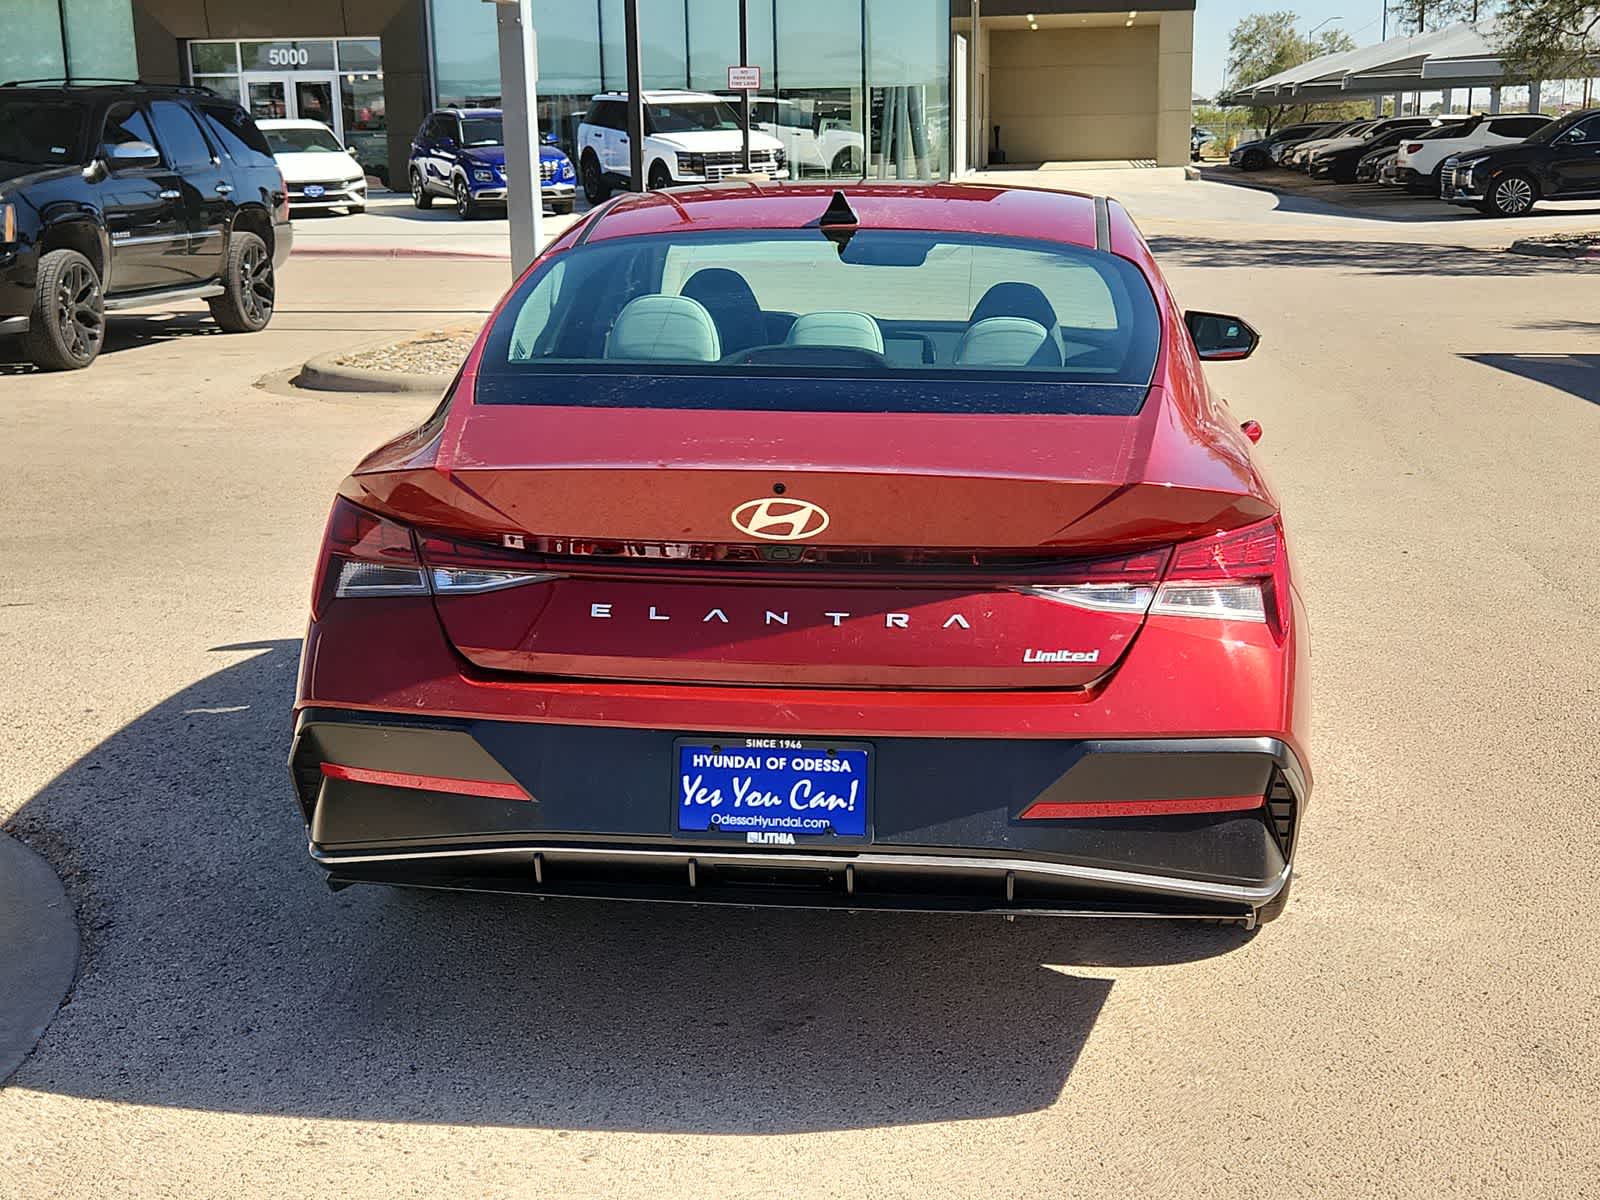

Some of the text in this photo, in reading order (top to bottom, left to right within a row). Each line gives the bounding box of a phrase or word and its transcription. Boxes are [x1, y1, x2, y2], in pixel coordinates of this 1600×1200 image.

[269, 48, 309, 66] 5000
[590, 602, 971, 630] ELANTRA
[1022, 648, 1100, 664] Limited
[745, 738, 803, 750] SINCE 1946
[692, 754, 853, 774] HYUNDAI OF ODESSA
[681, 774, 860, 812] Yes You Can!
[711, 813, 830, 829] OdessaHyundai.com
[758, 833, 795, 845] LITHIA
